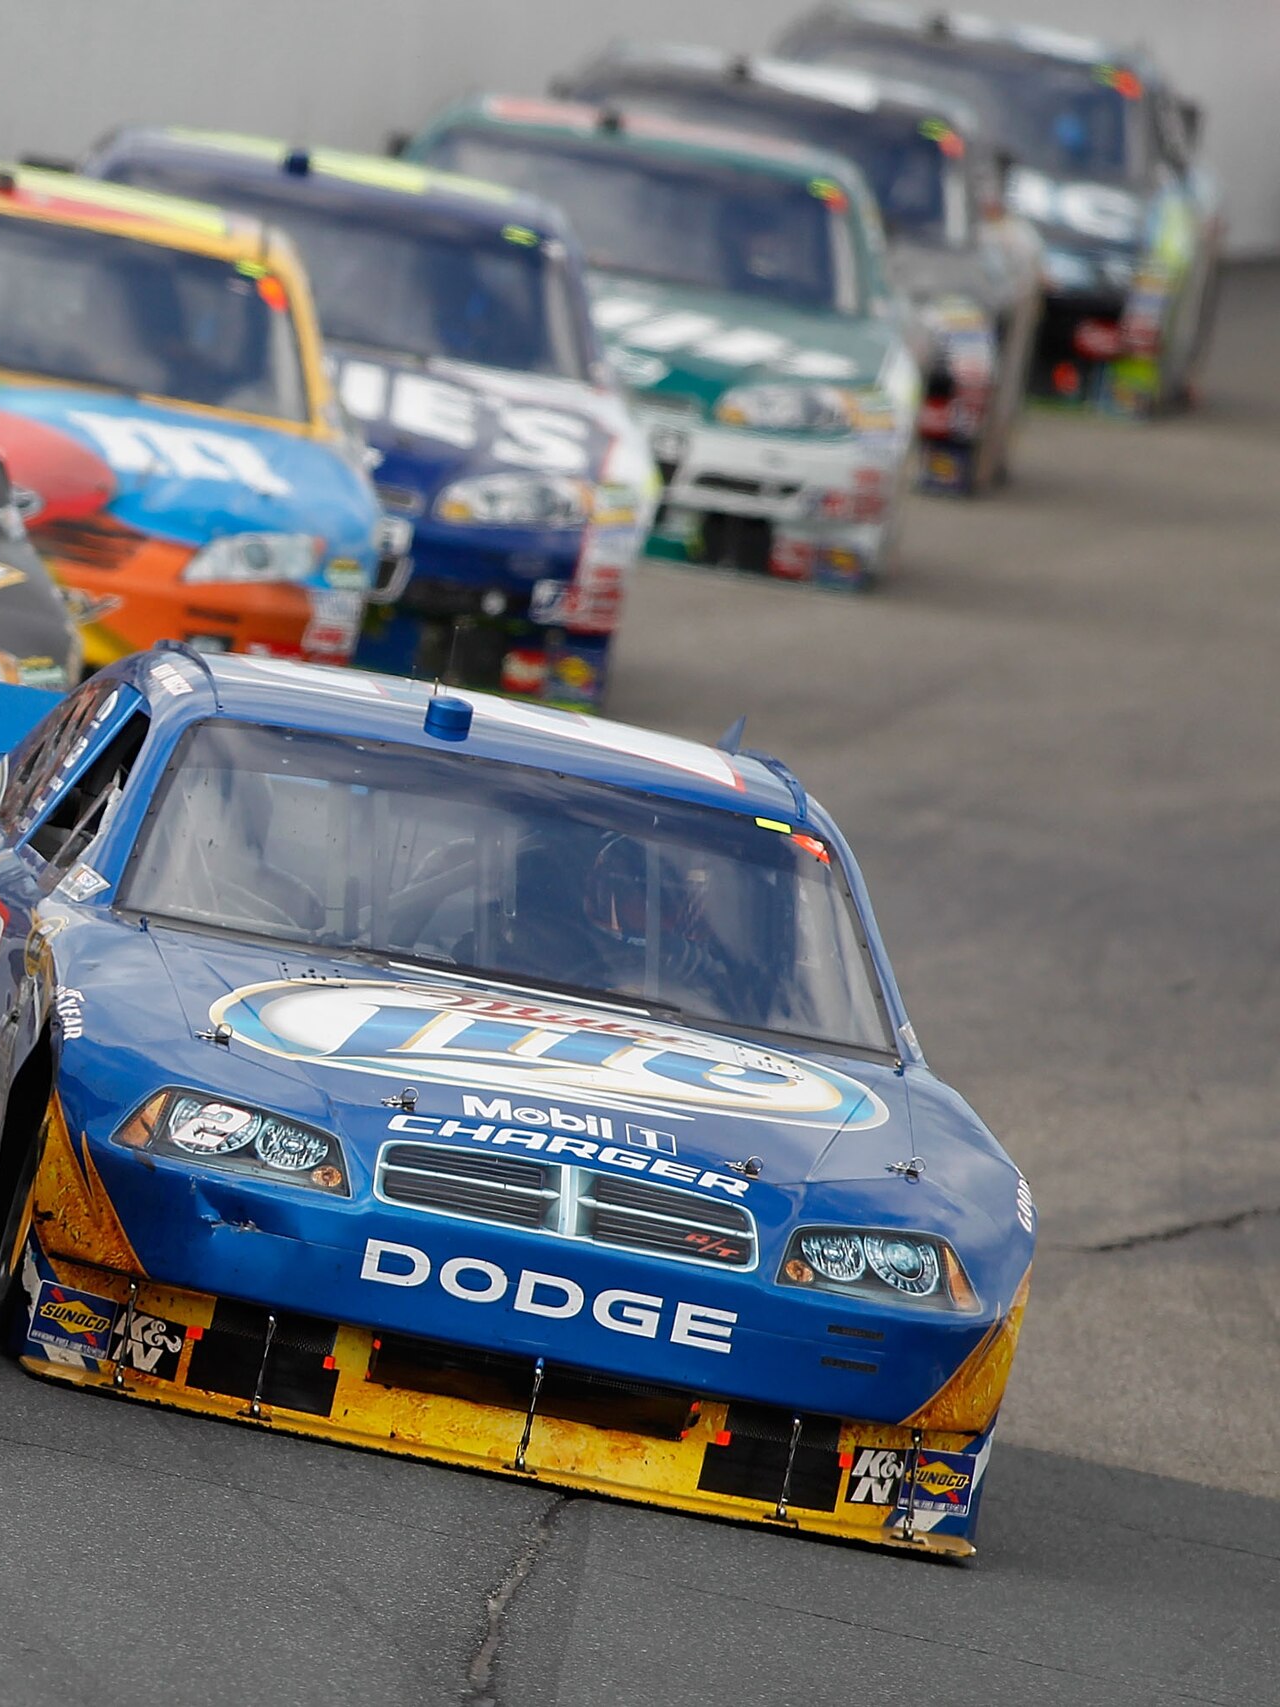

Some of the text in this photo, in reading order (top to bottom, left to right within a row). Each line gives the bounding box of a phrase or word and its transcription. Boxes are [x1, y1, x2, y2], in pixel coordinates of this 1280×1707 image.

[338, 360, 588, 472] ES
[410, 986, 710, 1050] Miller
[172, 1102, 253, 1148] 2
[462, 1095, 613, 1140] Mobil
[387, 1114, 751, 1198] CHARGER
[684, 1231, 739, 1257] R/T
[42, 1304, 110, 1331] SUNOCO
[360, 1238, 738, 1354] DODGE
